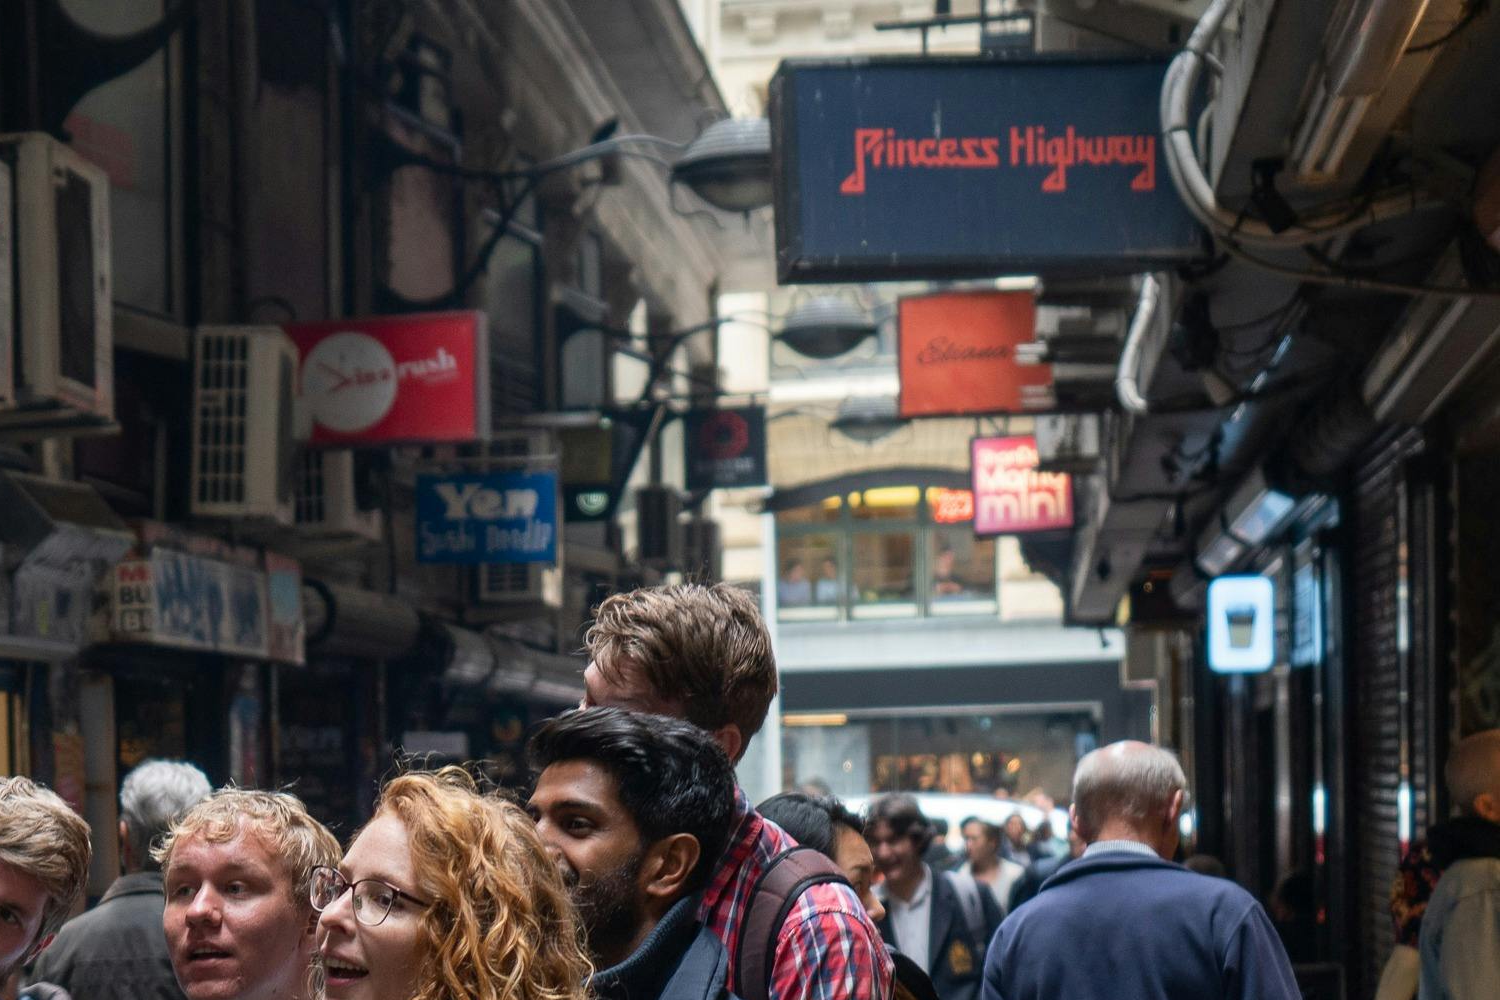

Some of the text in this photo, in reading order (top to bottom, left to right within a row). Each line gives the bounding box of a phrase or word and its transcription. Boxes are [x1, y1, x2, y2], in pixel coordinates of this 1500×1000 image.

[840, 126, 1156, 194] Princess Highway
[434, 482, 539, 521] Yen
